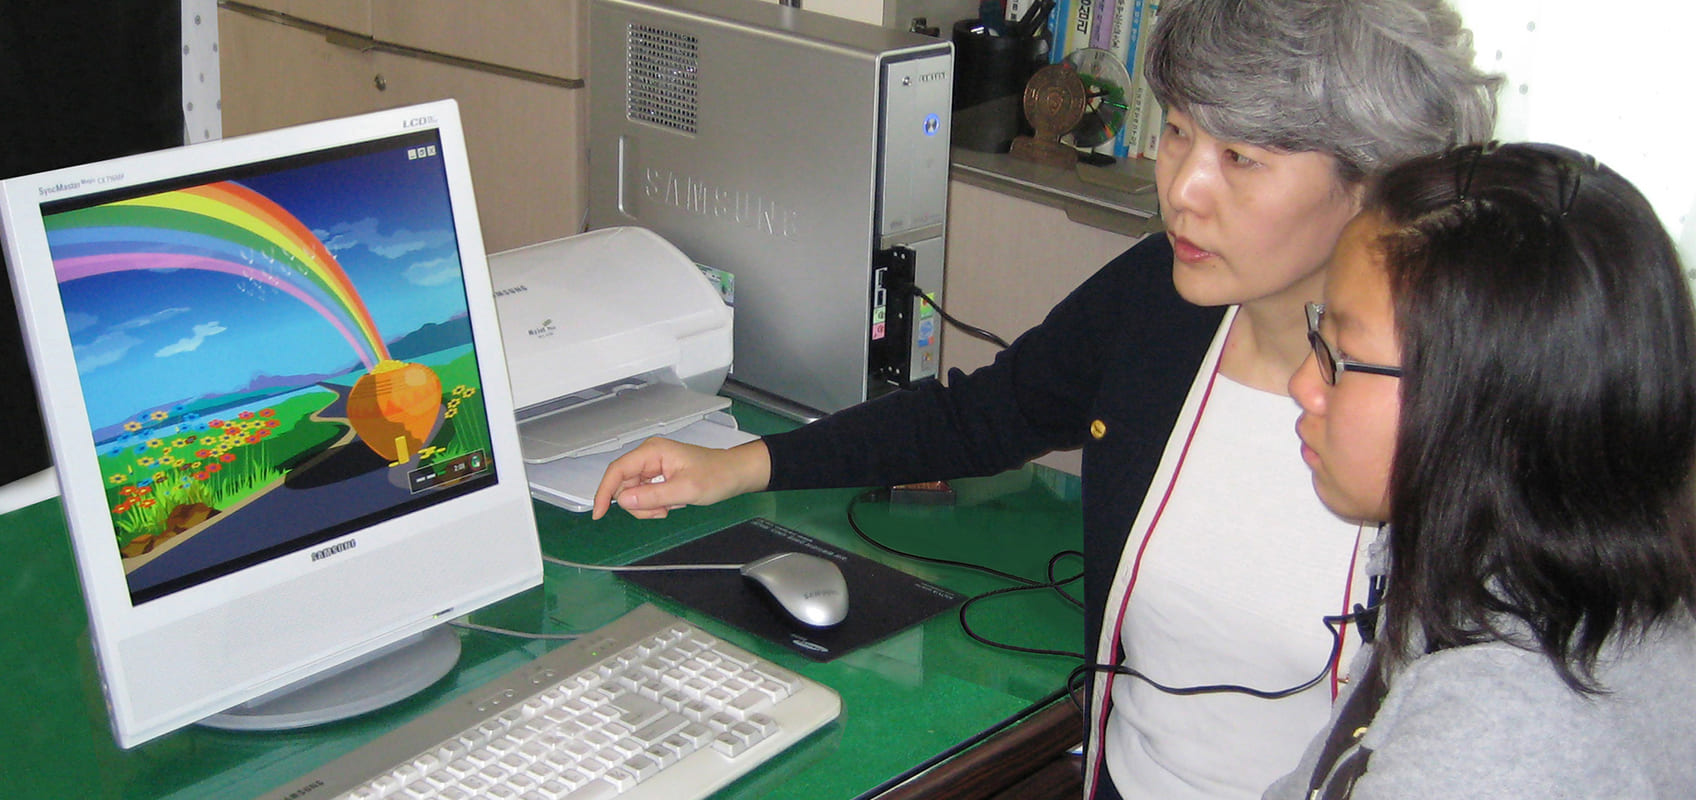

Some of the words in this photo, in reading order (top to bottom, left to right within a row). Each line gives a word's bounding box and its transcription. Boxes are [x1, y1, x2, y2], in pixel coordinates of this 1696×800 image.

[38, 182, 81, 197] SyncMaster
[645, 167, 798, 241] SAMSUNG
[311, 538, 356, 562] SAMSUNG
